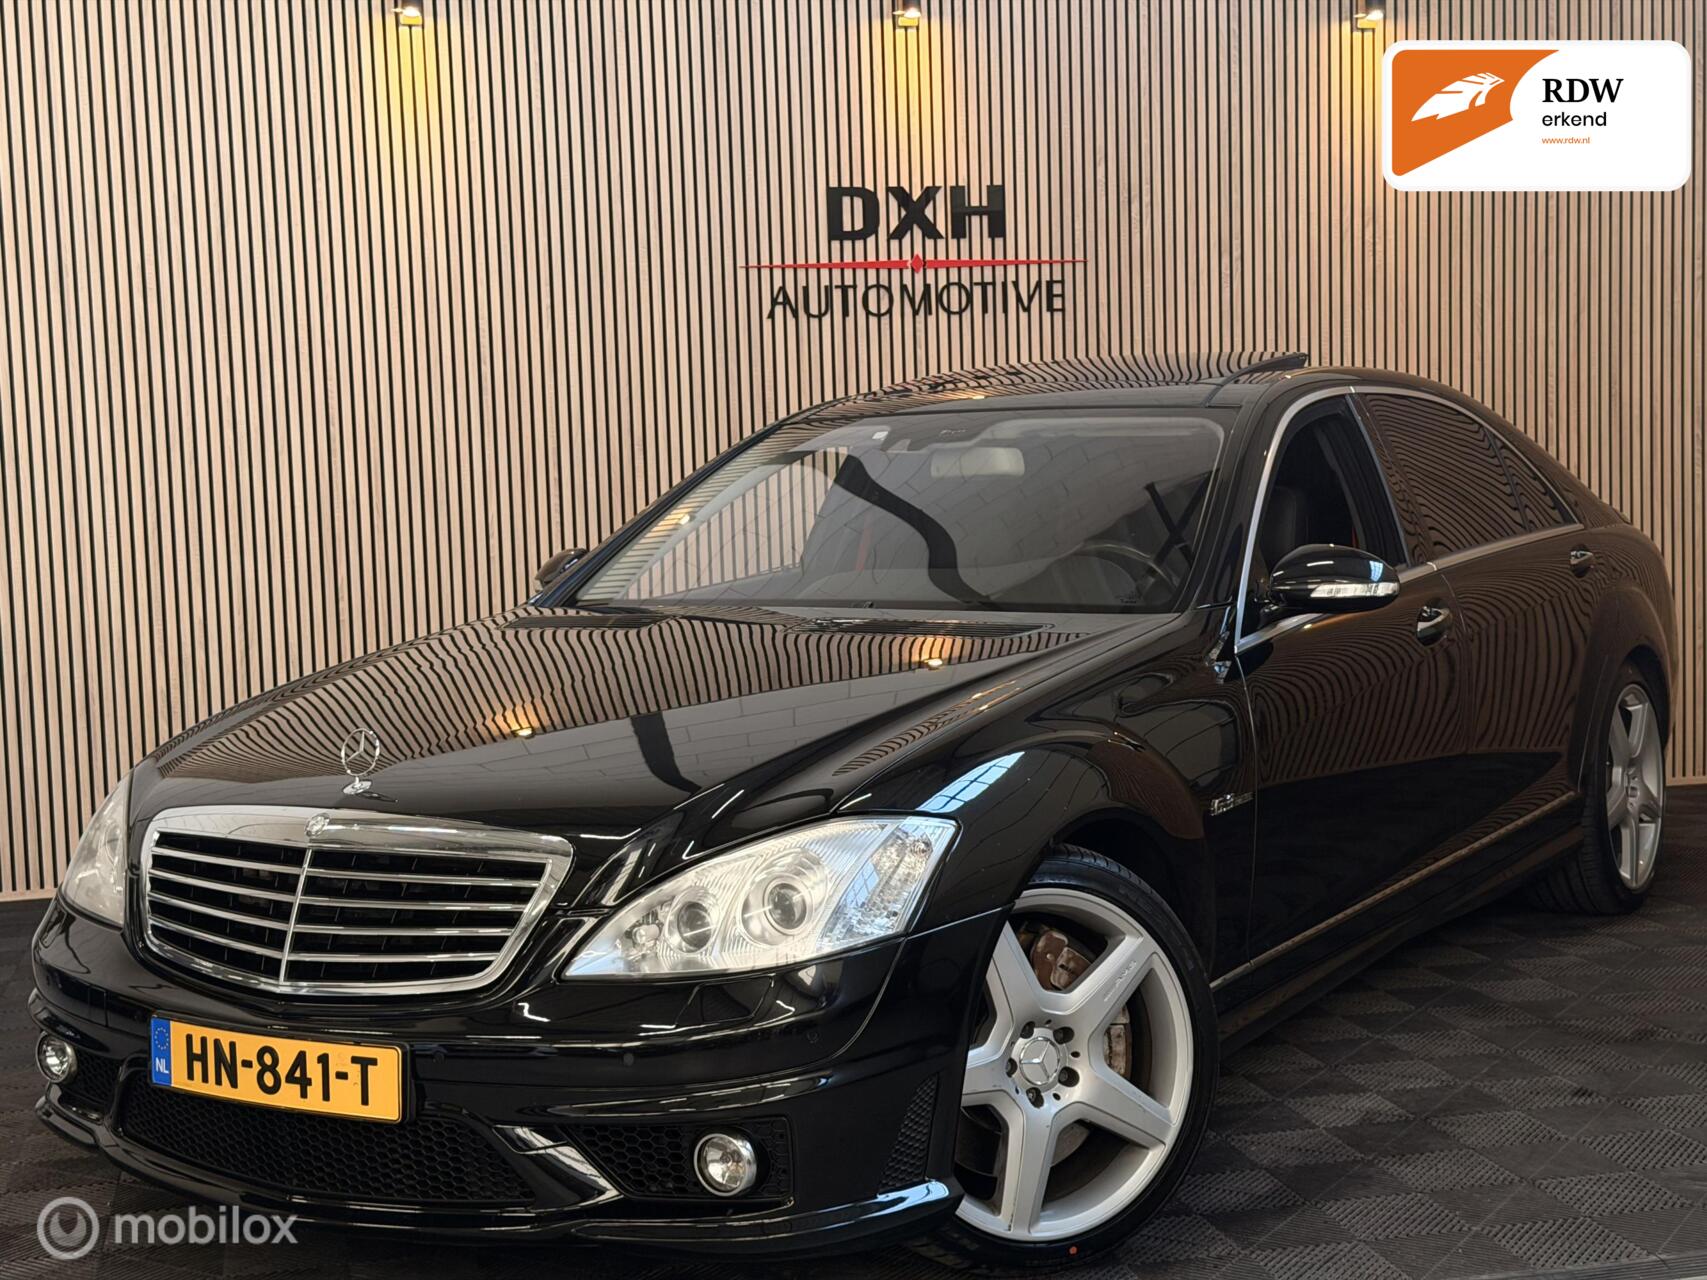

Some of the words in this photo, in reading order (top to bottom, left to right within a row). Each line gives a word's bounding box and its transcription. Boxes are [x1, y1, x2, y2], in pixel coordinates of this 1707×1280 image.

[826, 184, 1006, 241] DXH
[767, 279, 1065, 319] AUTOMOTIVE
[155, 1058, 169, 1074] NL
[185, 1033, 378, 1107] HN-841-T
